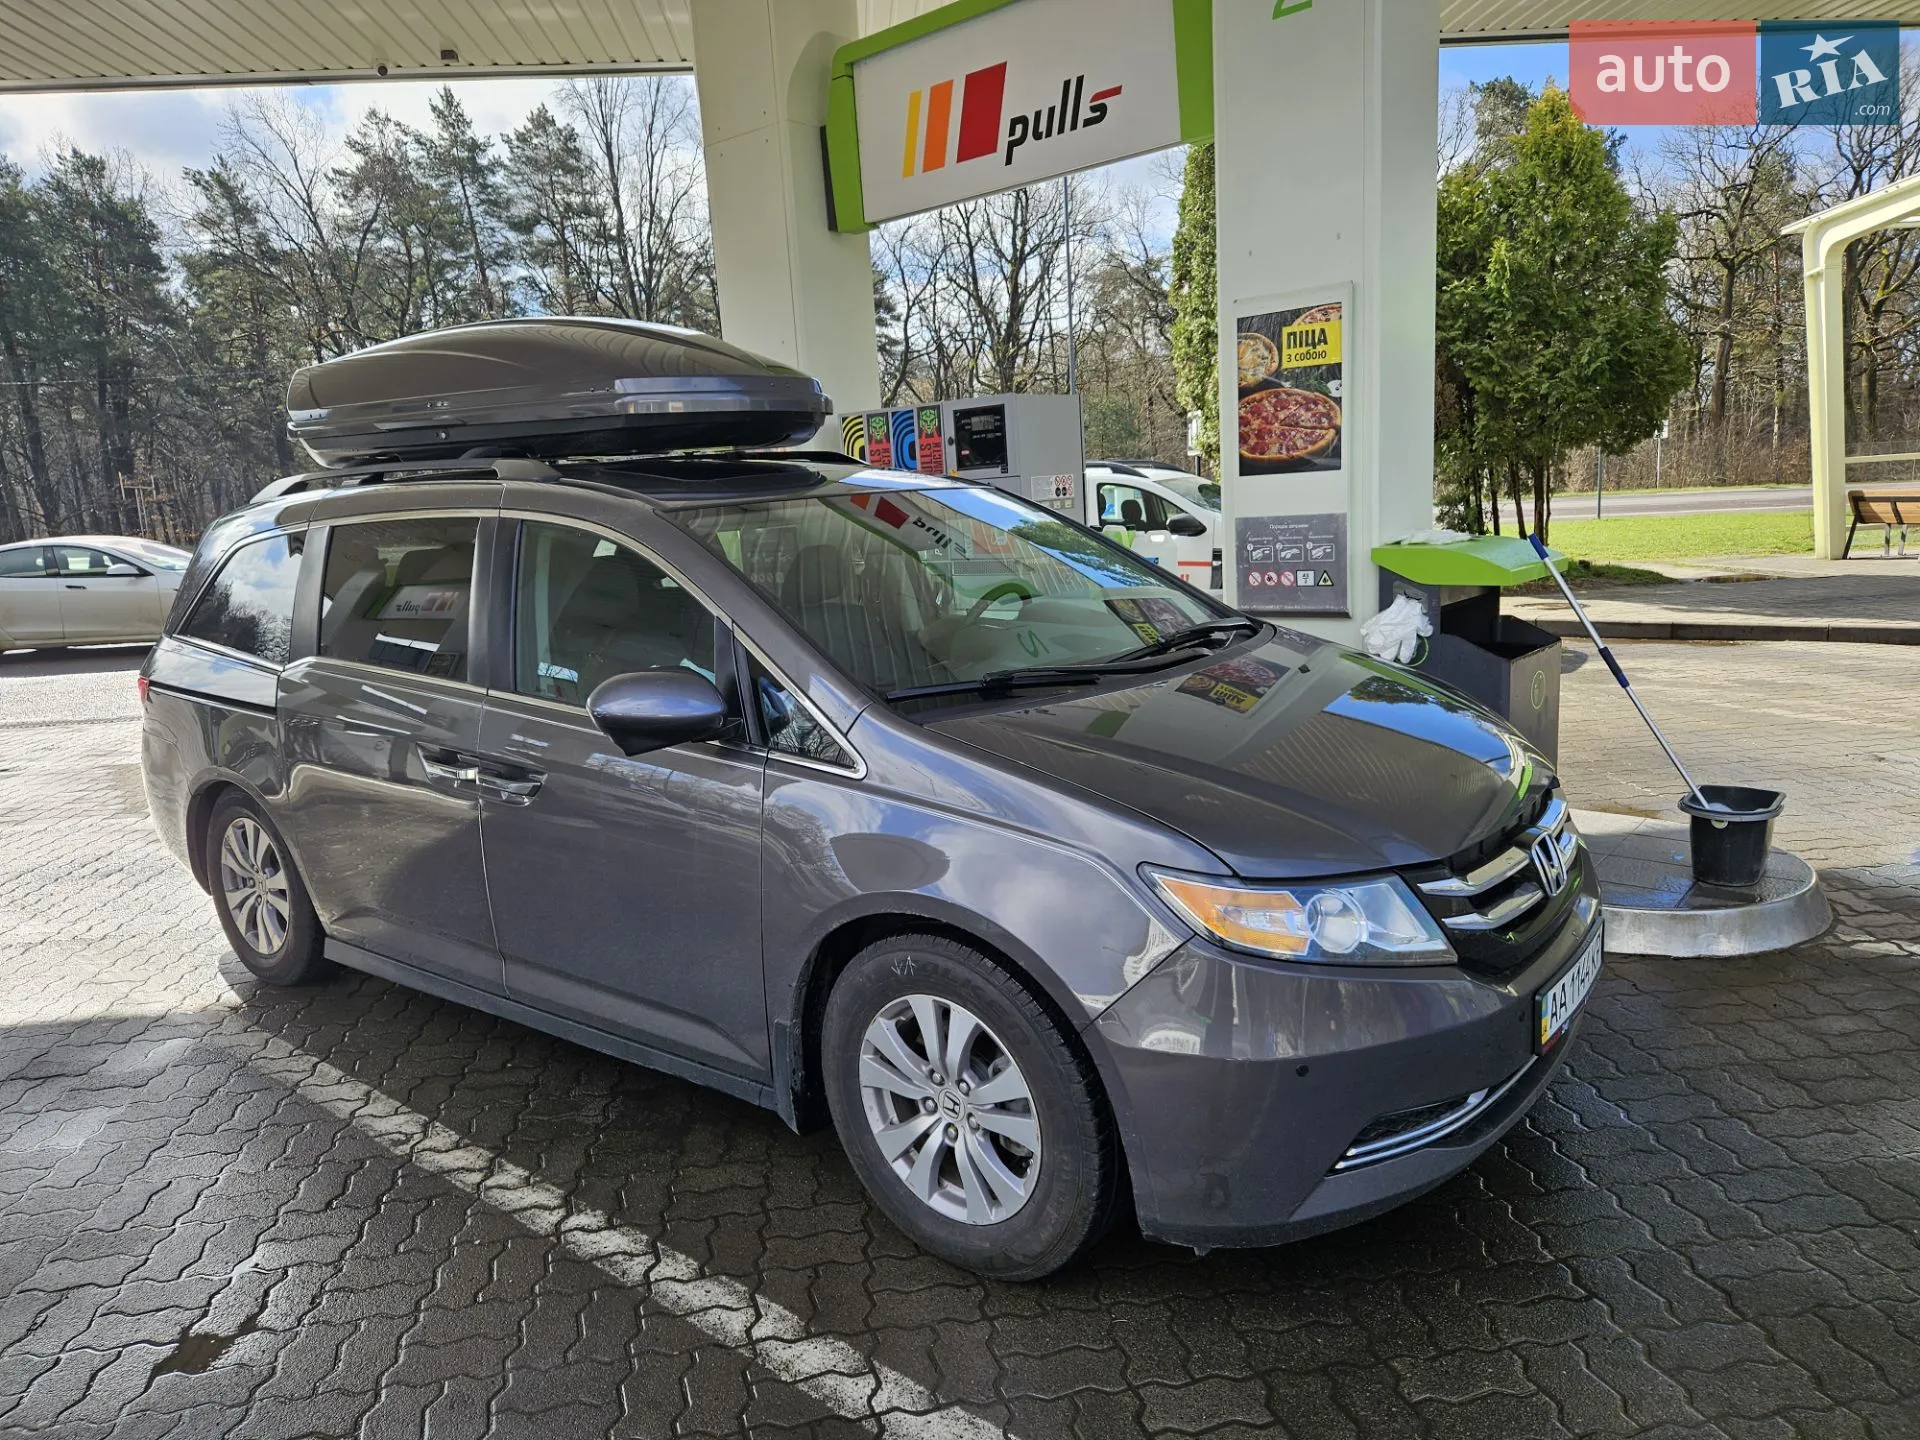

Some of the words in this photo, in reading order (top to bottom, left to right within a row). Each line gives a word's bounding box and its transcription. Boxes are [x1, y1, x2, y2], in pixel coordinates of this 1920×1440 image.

[1004, 74, 1123, 167] pulls
[1286, 327, 1329, 350] ПІЦА
[1550, 982, 1568, 1029] AA
